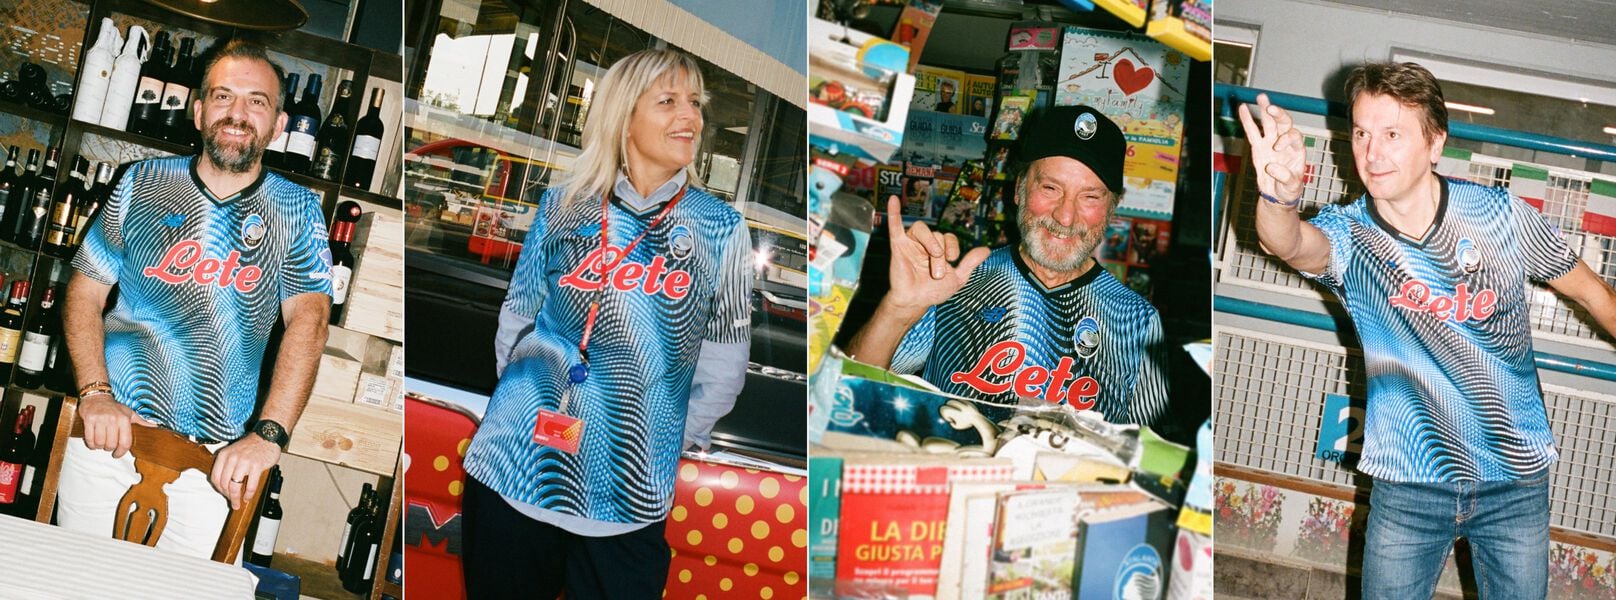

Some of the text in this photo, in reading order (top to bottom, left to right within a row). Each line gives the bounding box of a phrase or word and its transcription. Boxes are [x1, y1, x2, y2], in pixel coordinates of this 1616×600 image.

[1096, 61, 1112, 79] I
[143, 240, 262, 293] Lete
[558, 245, 691, 299] Lete
[1388, 279, 1497, 323] Lete
[950, 340, 1100, 411] Lete
[1333, 406, 1366, 454] 2
[855, 544, 926, 562] GIUSTA
[870, 521, 902, 542] LA
